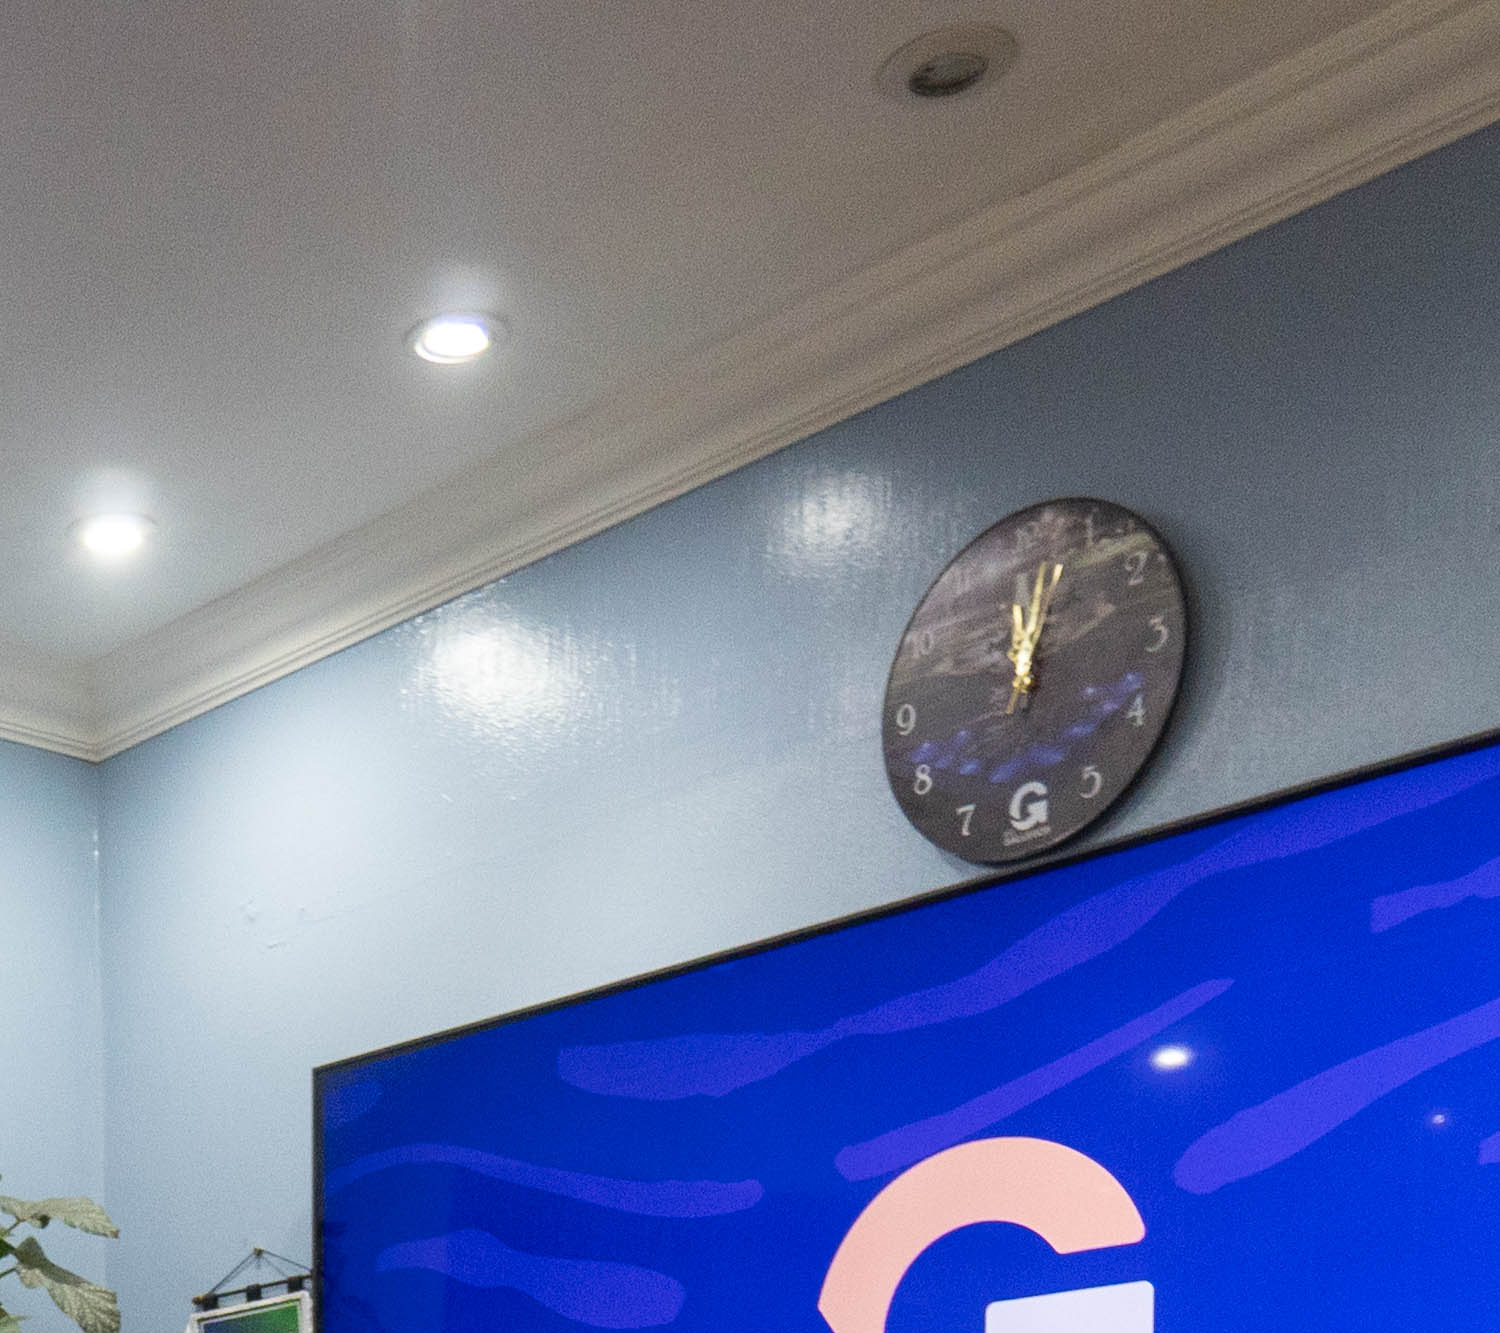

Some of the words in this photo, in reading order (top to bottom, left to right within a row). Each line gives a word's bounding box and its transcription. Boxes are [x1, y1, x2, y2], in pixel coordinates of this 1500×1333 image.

[1125, 552, 1147, 585] 2
[1146, 617, 1169, 653] 3
[896, 703, 916, 735] 9
[1127, 694, 1146, 727] 4
[913, 763, 933, 795] 8
[1080, 765, 1101, 799] 5
[956, 803, 976, 837] 7
